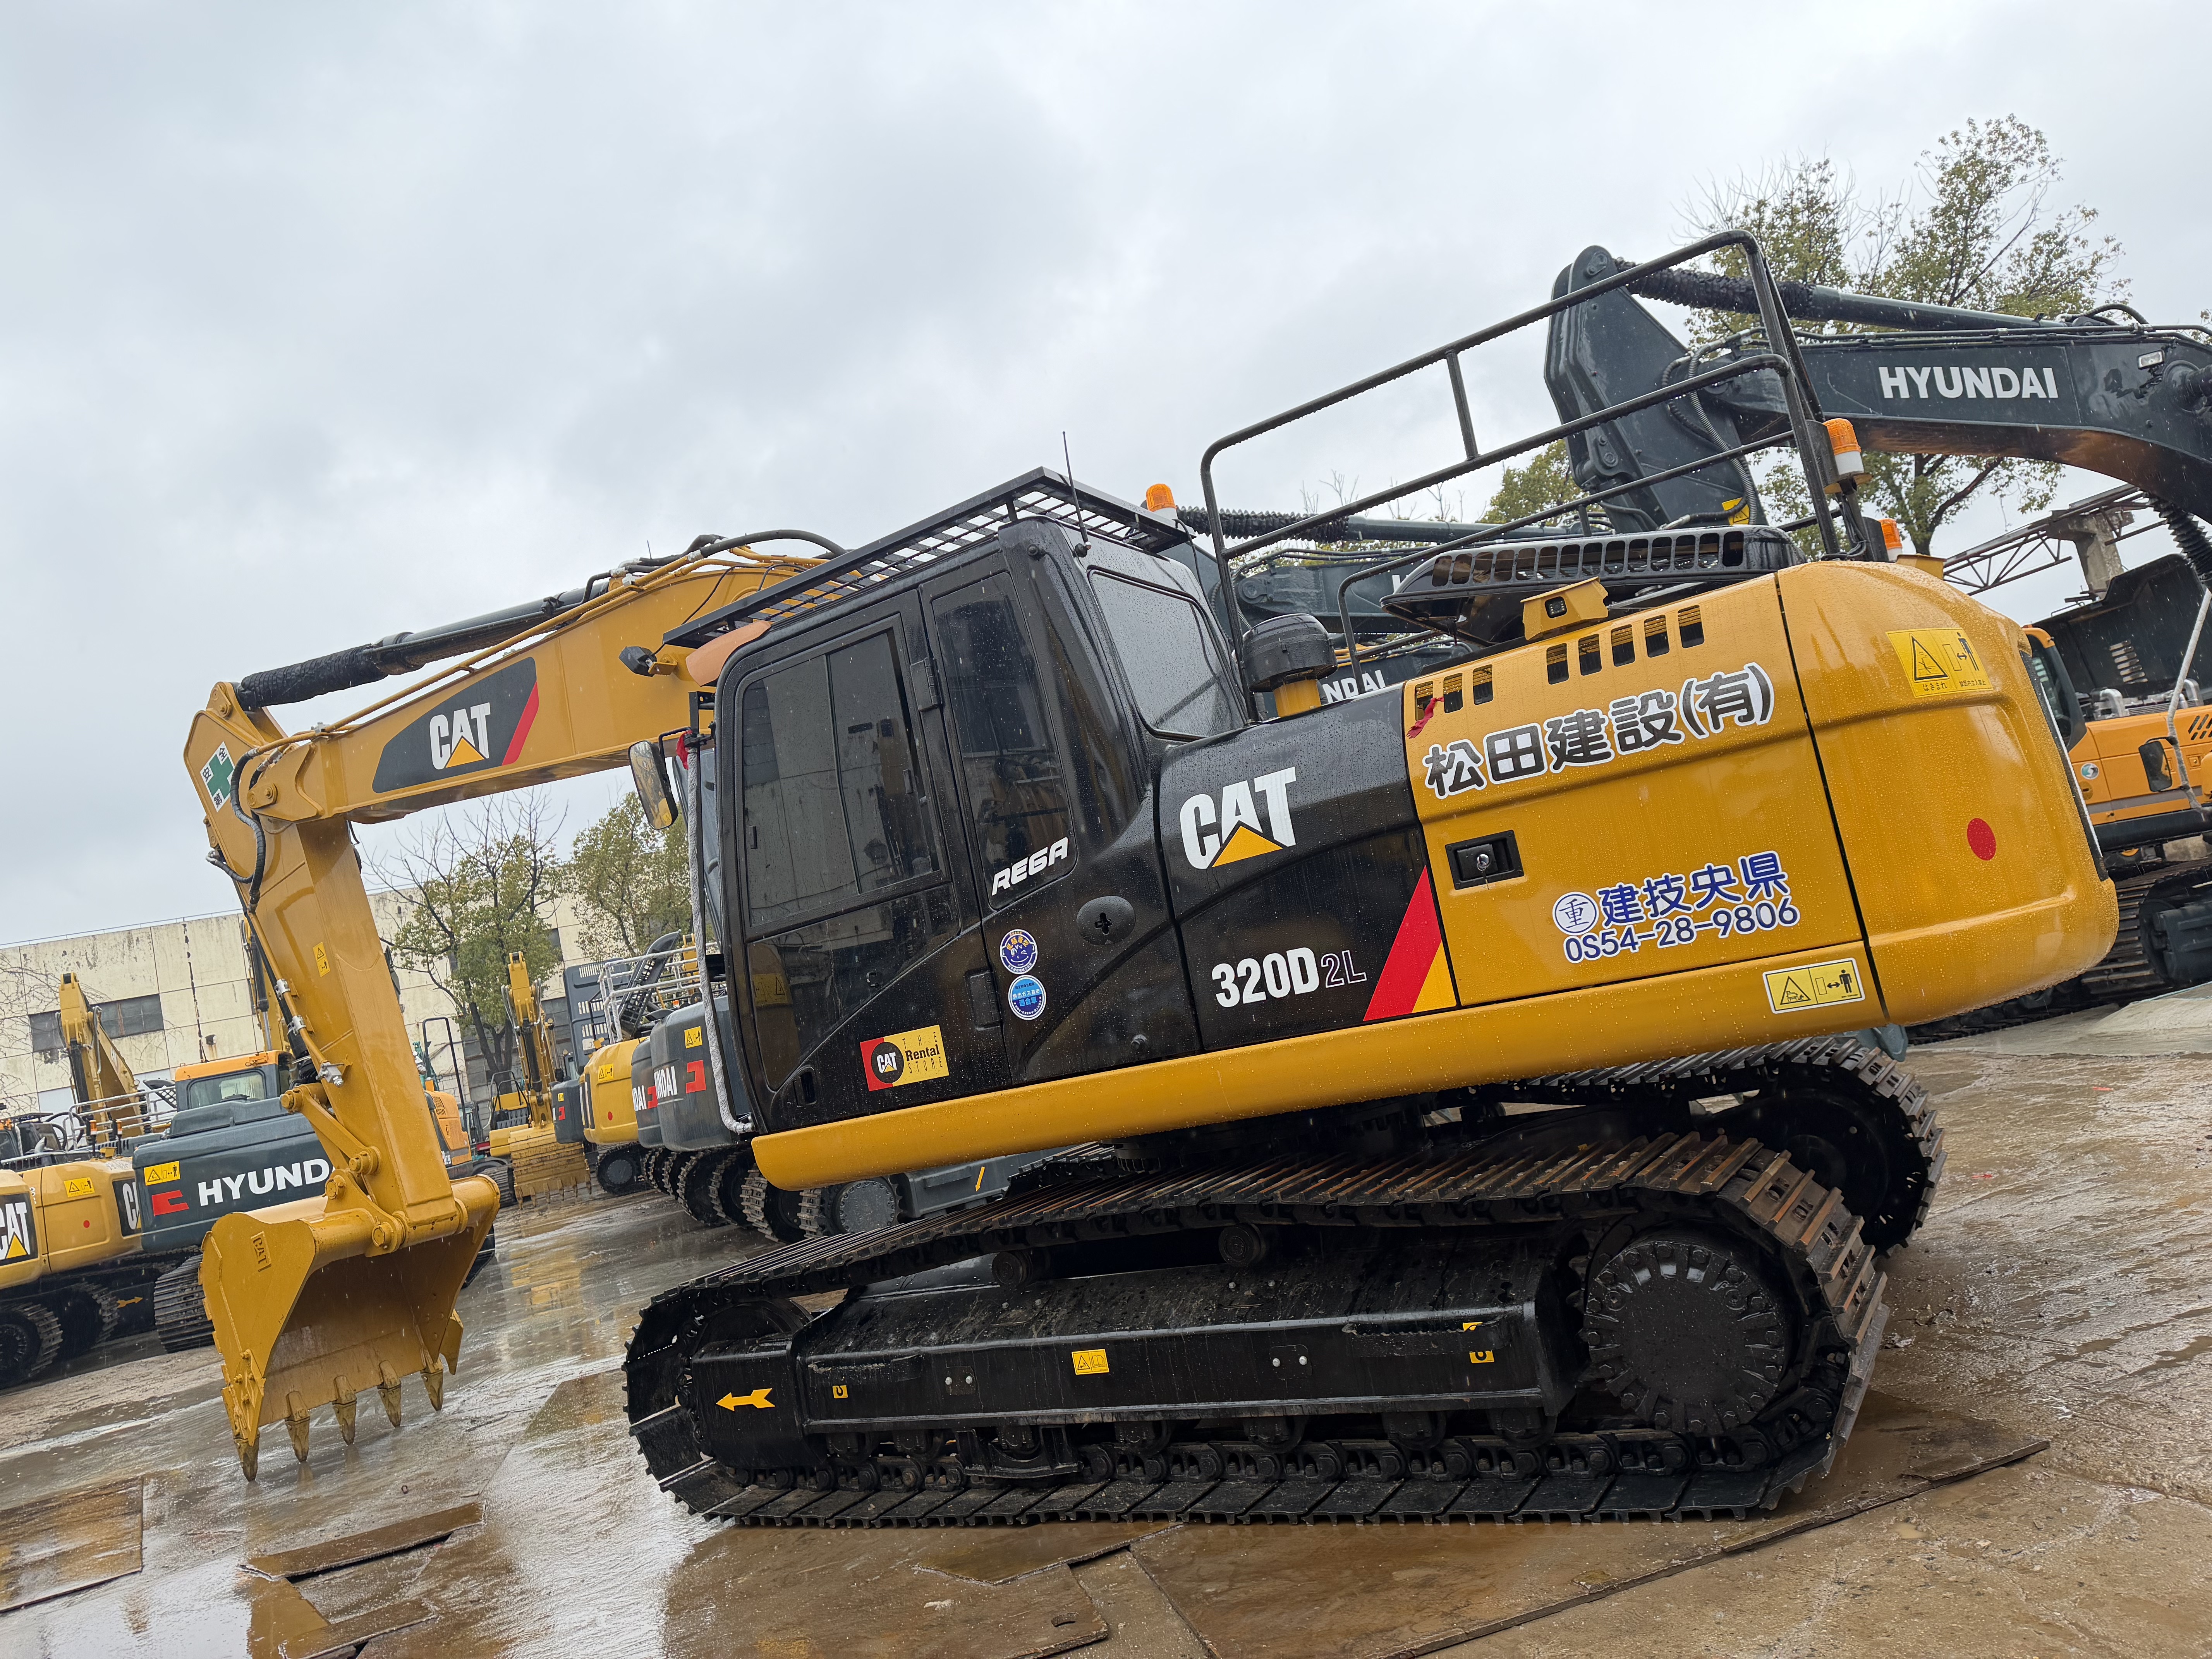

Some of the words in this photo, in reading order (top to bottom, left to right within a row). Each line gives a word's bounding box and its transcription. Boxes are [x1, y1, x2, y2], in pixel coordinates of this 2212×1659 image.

[1879, 366, 2059, 398] HYUNDAI
[429, 702, 491, 769] CAT
[1424, 663, 1773, 797] 松田建設(有)
[1180, 767, 1296, 869] CAT
[992, 837, 1068, 896] REGA
[902, 1032, 937, 1049] THE
[905, 1044, 940, 1061] Rental
[877, 1052, 897, 1073] CAT
[908, 1056, 943, 1074] STORE
[198, 1159, 335, 1206] HYUND
[253, 1237, 268, 1264] CAT
